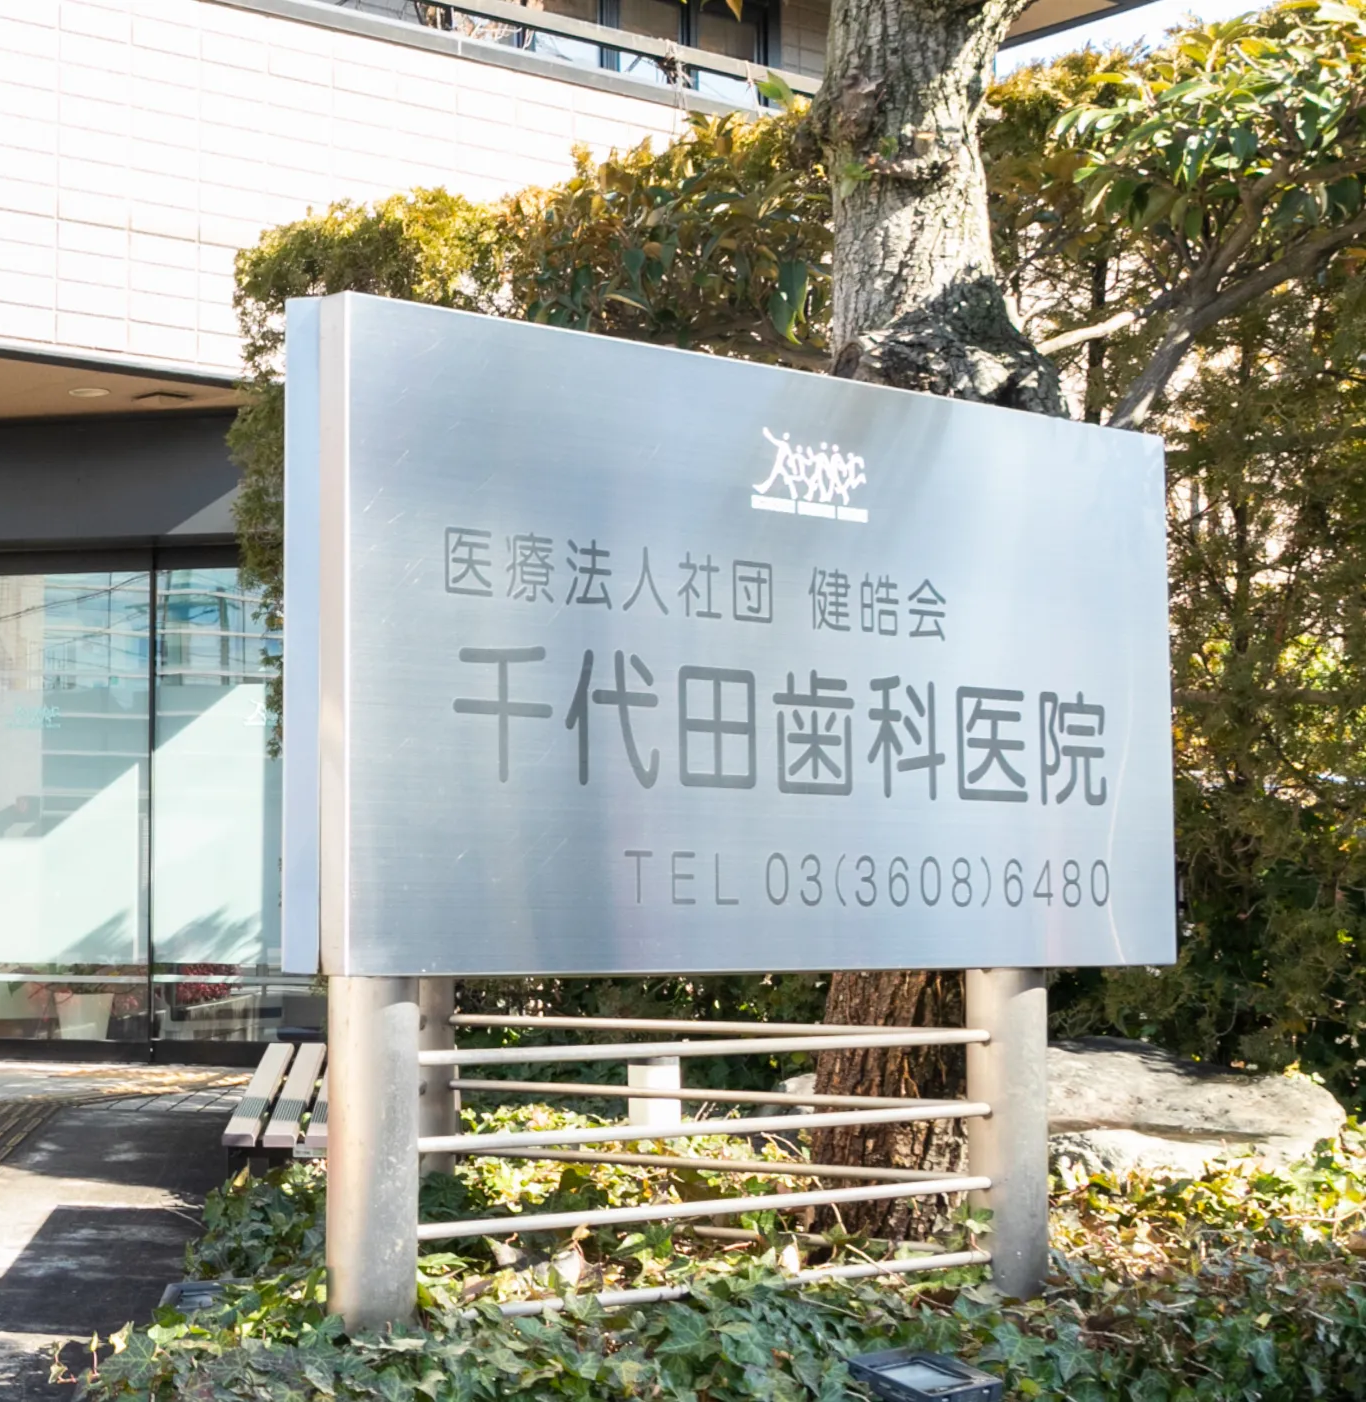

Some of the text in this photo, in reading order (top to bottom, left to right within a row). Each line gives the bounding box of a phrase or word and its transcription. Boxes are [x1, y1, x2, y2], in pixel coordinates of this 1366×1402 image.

[443, 526, 948, 642] 医療法人社団 健皓会
[452, 645, 1108, 807] 千代田歯科医院
[623, 850, 1111, 909] TEL 03(3608)6480
